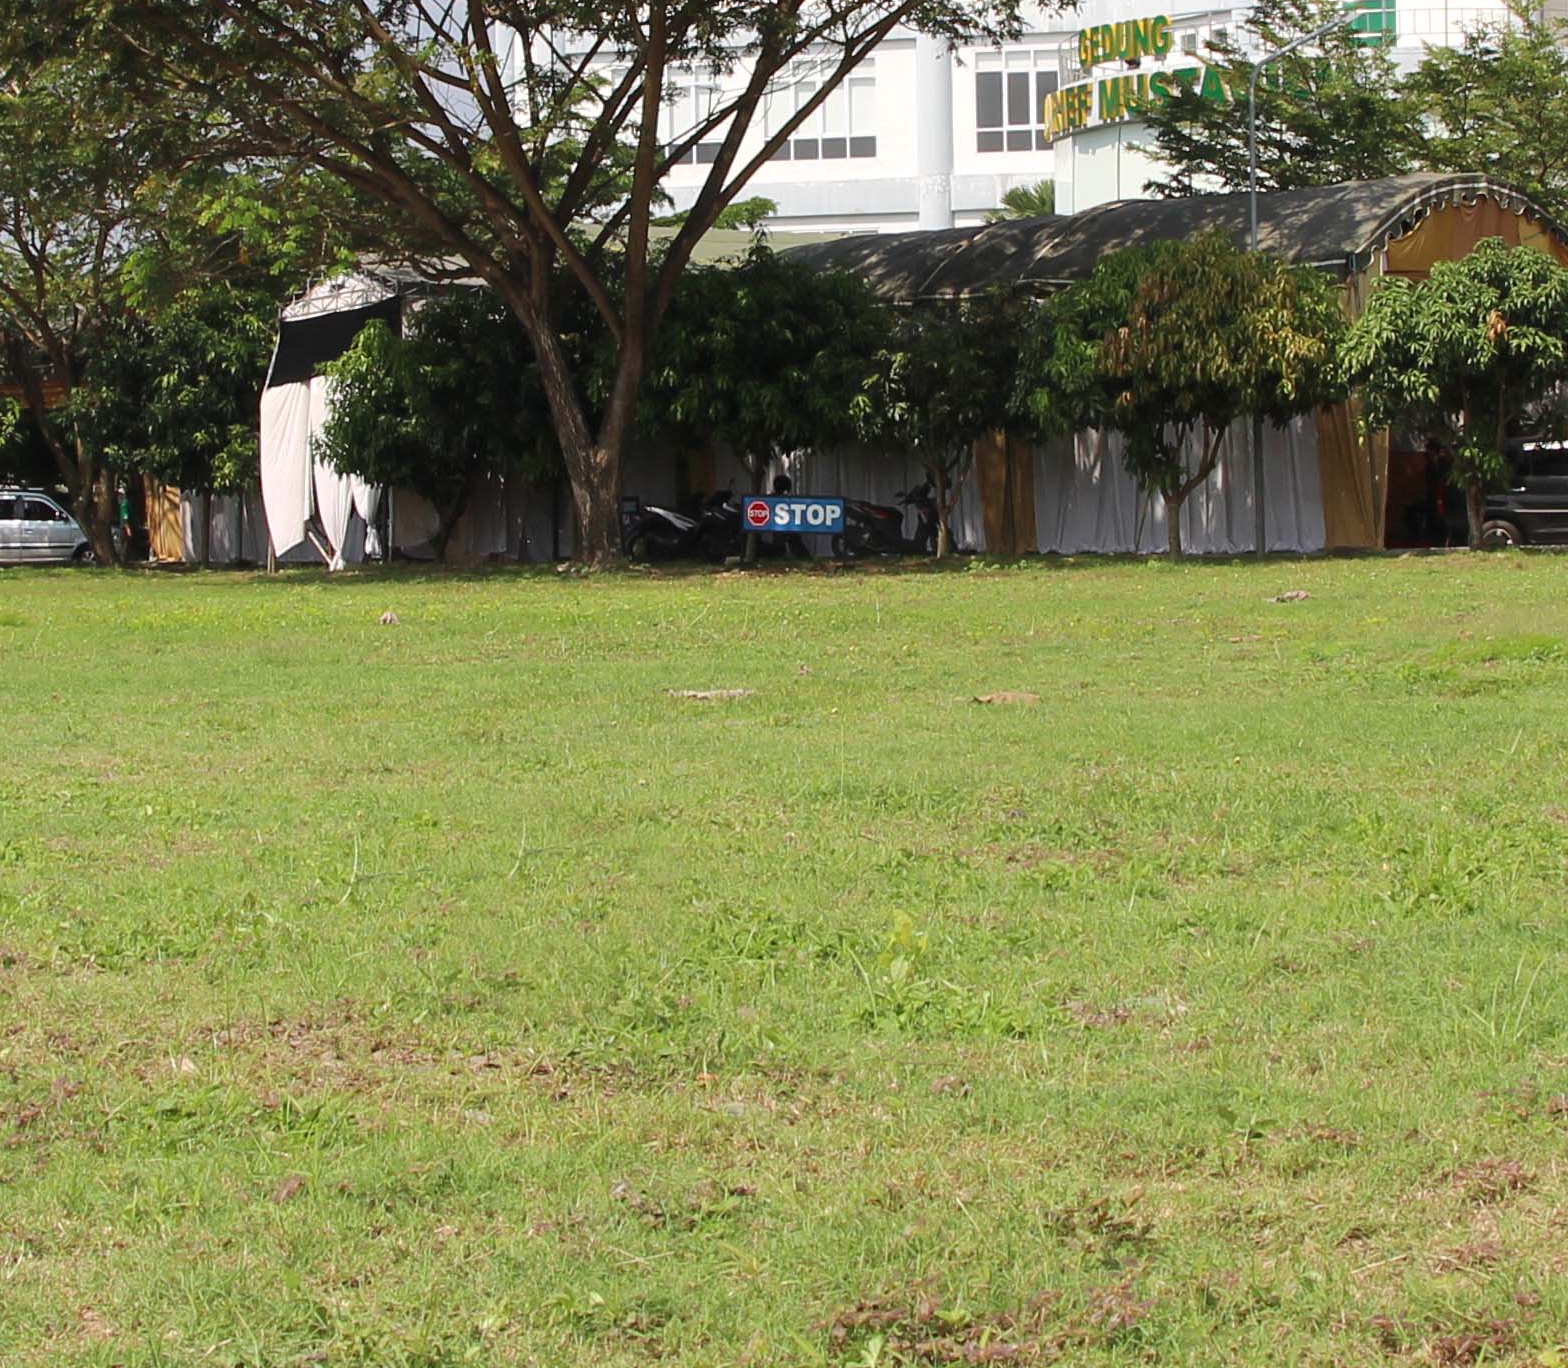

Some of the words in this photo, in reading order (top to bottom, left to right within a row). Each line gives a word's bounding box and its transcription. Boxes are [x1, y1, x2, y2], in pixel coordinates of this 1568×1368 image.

[1078, 15, 1173, 67] GEDUNG
[748, 509, 769, 518] STOP
[774, 503, 841, 526] STOP
